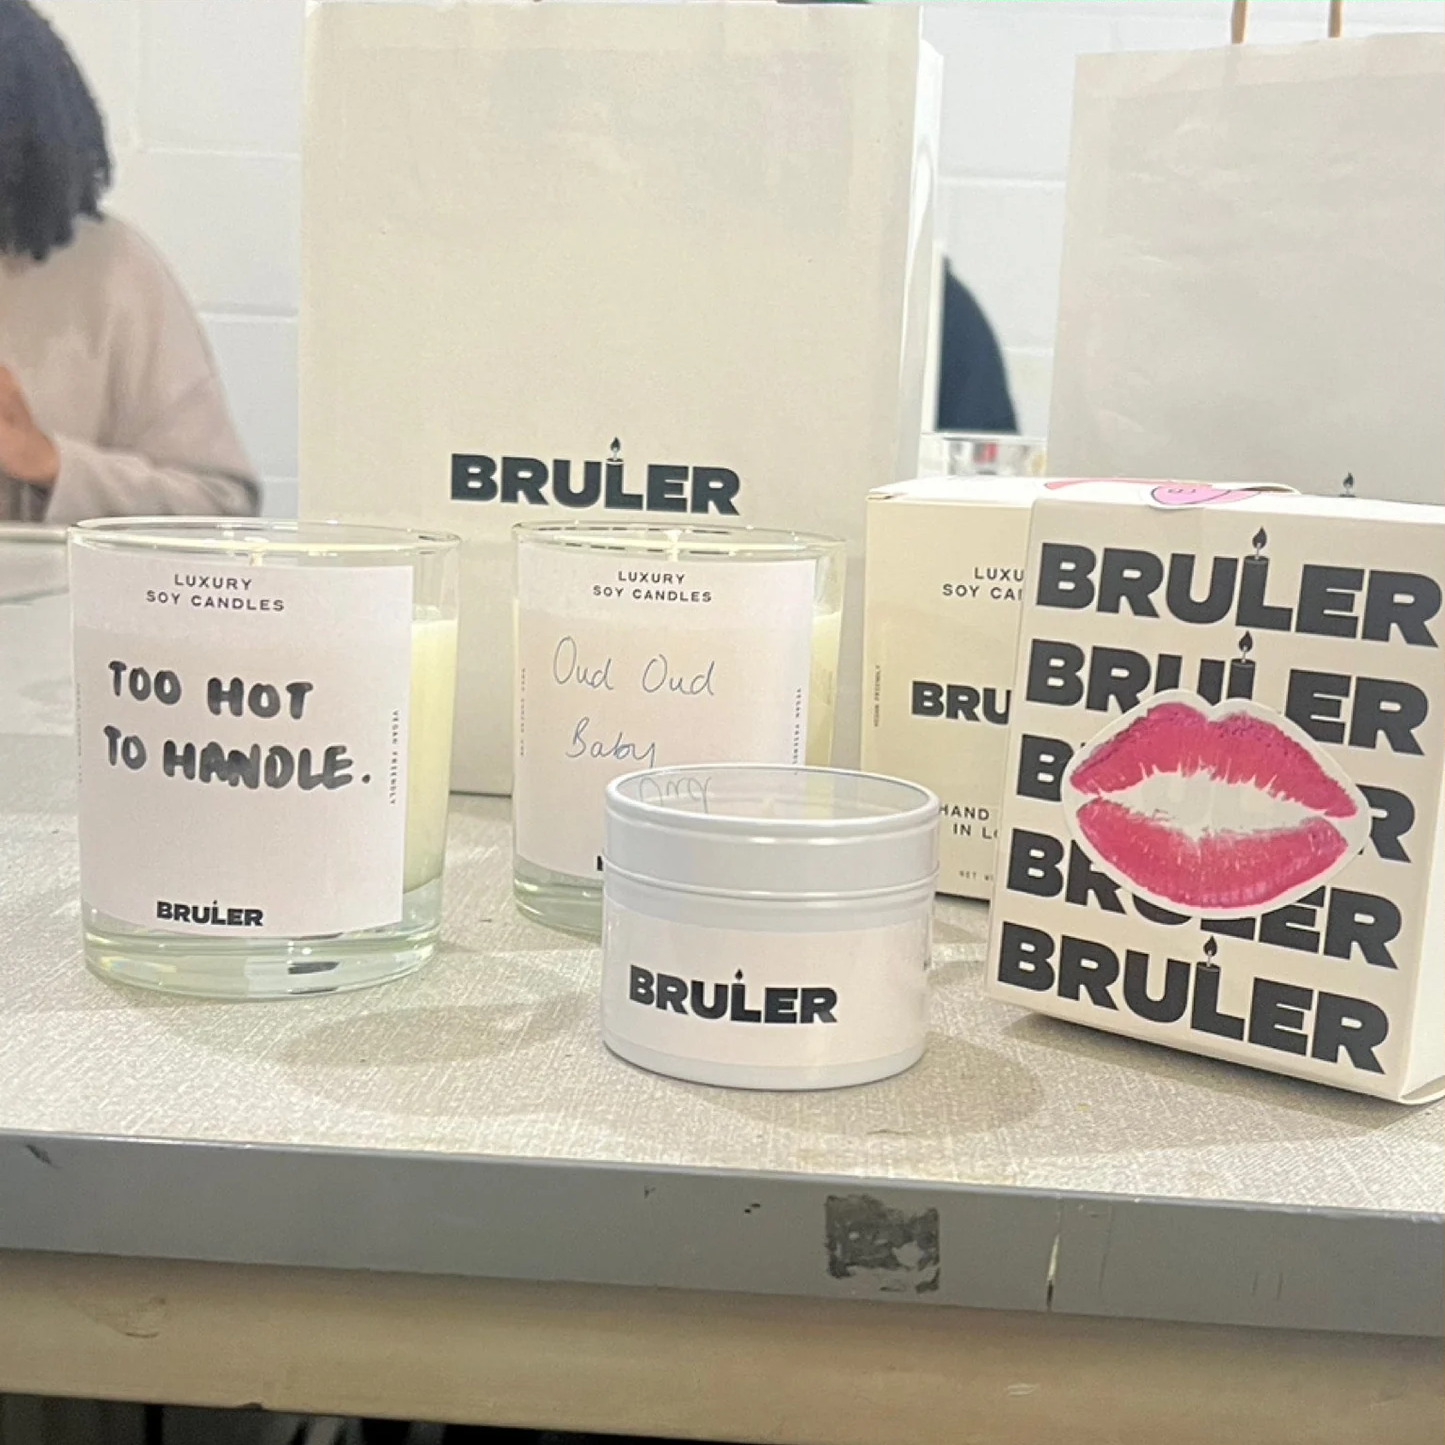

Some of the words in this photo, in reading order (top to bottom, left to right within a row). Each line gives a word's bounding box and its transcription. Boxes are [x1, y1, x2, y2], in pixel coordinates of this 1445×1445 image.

[451, 453, 740, 516] BRULER
[174, 573, 252, 592] LUXURY
[592, 585, 624, 598] SOY
[632, 588, 712, 603] CANDLES
[618, 570, 686, 584] LUXURY
[942, 583, 981, 598] SOY
[974, 567, 1024, 583] LUXU
[146, 590, 181, 606] SOY
[190, 595, 285, 612] CANDLES
[1036, 542, 1442, 648] BRULER
[553, 636, 615, 690] Oud
[642, 653, 715, 696] Oud
[108, 660, 182, 706] TOO
[206, 677, 314, 720] HOT
[912, 681, 1012, 725] BRU
[392, 710, 400, 744] VEGAN
[565, 716, 656, 768] Baby
[103, 725, 147, 771] TO
[163, 740, 371, 791] HANDLE.
[390, 750, 399, 805] FRIENDLY
[939, 804, 990, 821] HAND
[953, 823, 971, 836] IN
[156, 901, 264, 927] BRULER
[630, 965, 838, 1024] BRULER
[997, 921, 1389, 1074] BRULER
